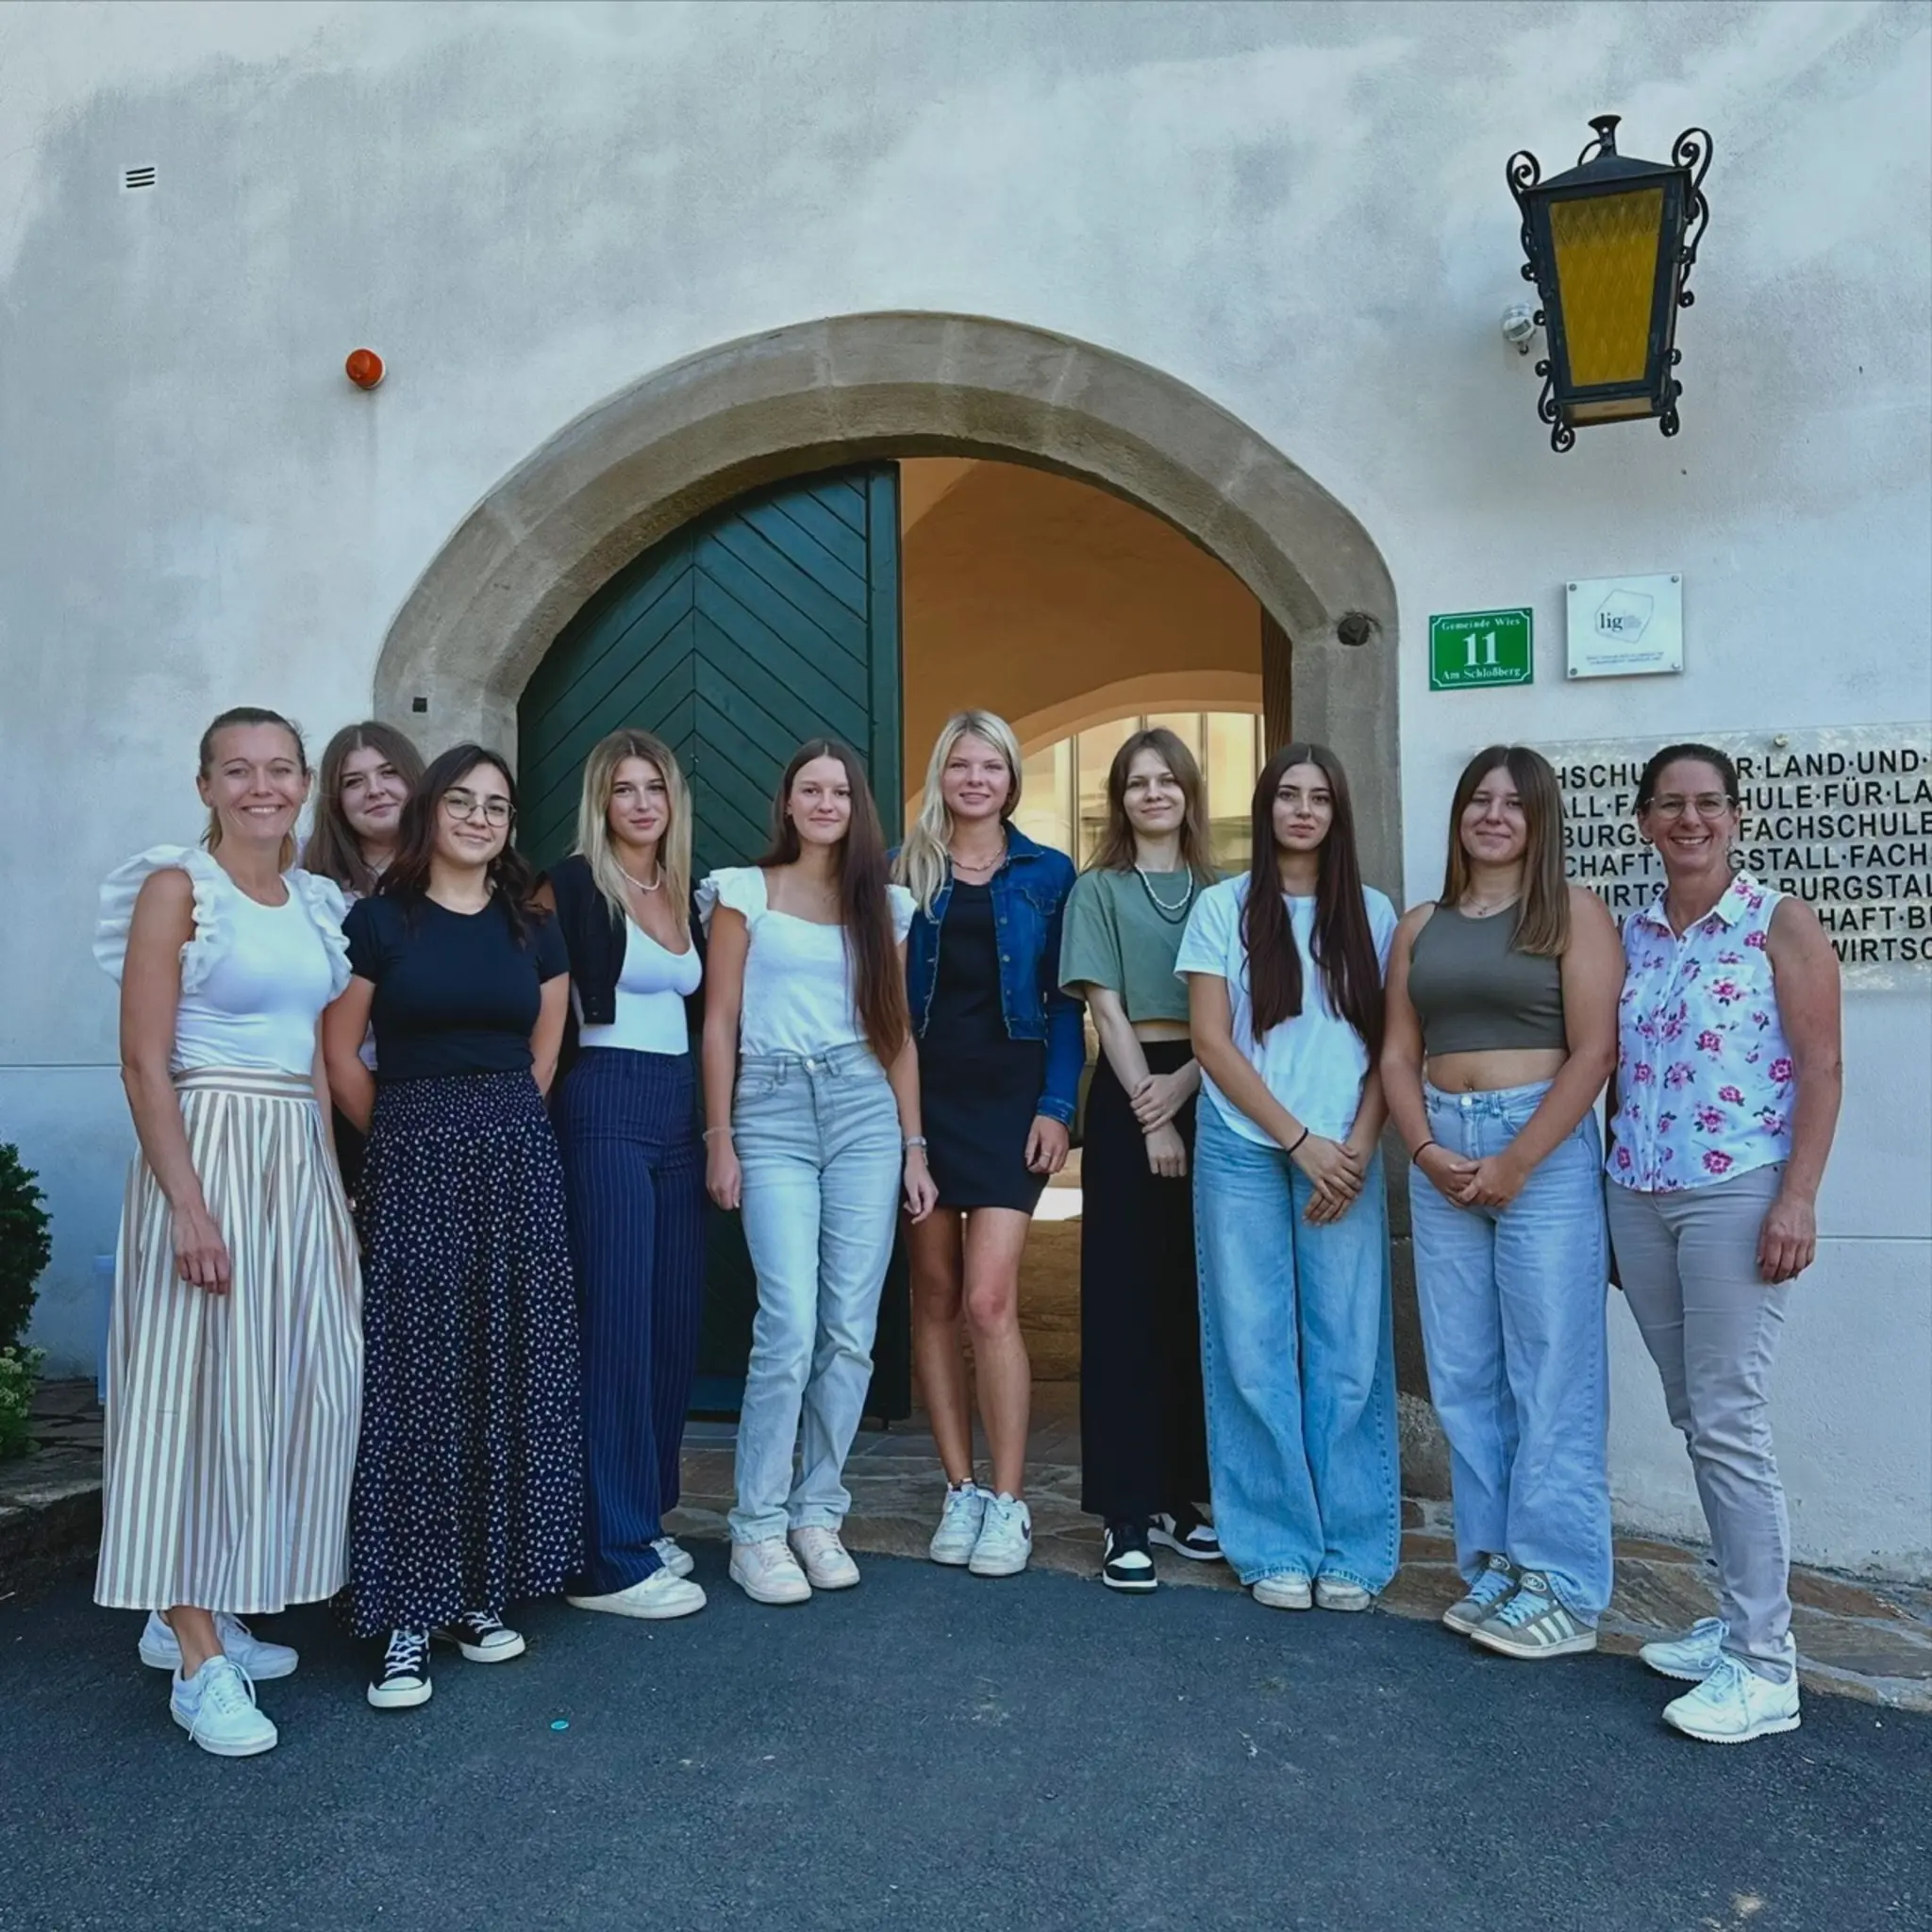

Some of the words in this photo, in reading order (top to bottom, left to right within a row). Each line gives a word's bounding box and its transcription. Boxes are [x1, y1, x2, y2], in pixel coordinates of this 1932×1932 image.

[1441, 619, 1491, 631] Gemeinde
[1494, 617, 1521, 626] Wies
[1600, 611, 1624, 633] lig
[1463, 631, 1500, 667] 11
[1441, 671, 1460, 680] Am
[1463, 666, 1521, 680] Schloßberg
[1765, 752, 1845, 778] LAND
[1857, 749, 1919, 774] UND
[1824, 776, 1883, 808] FÜR
[1739, 811, 1932, 841] FACHSCHULE
[1850, 842, 1932, 868] FACH
